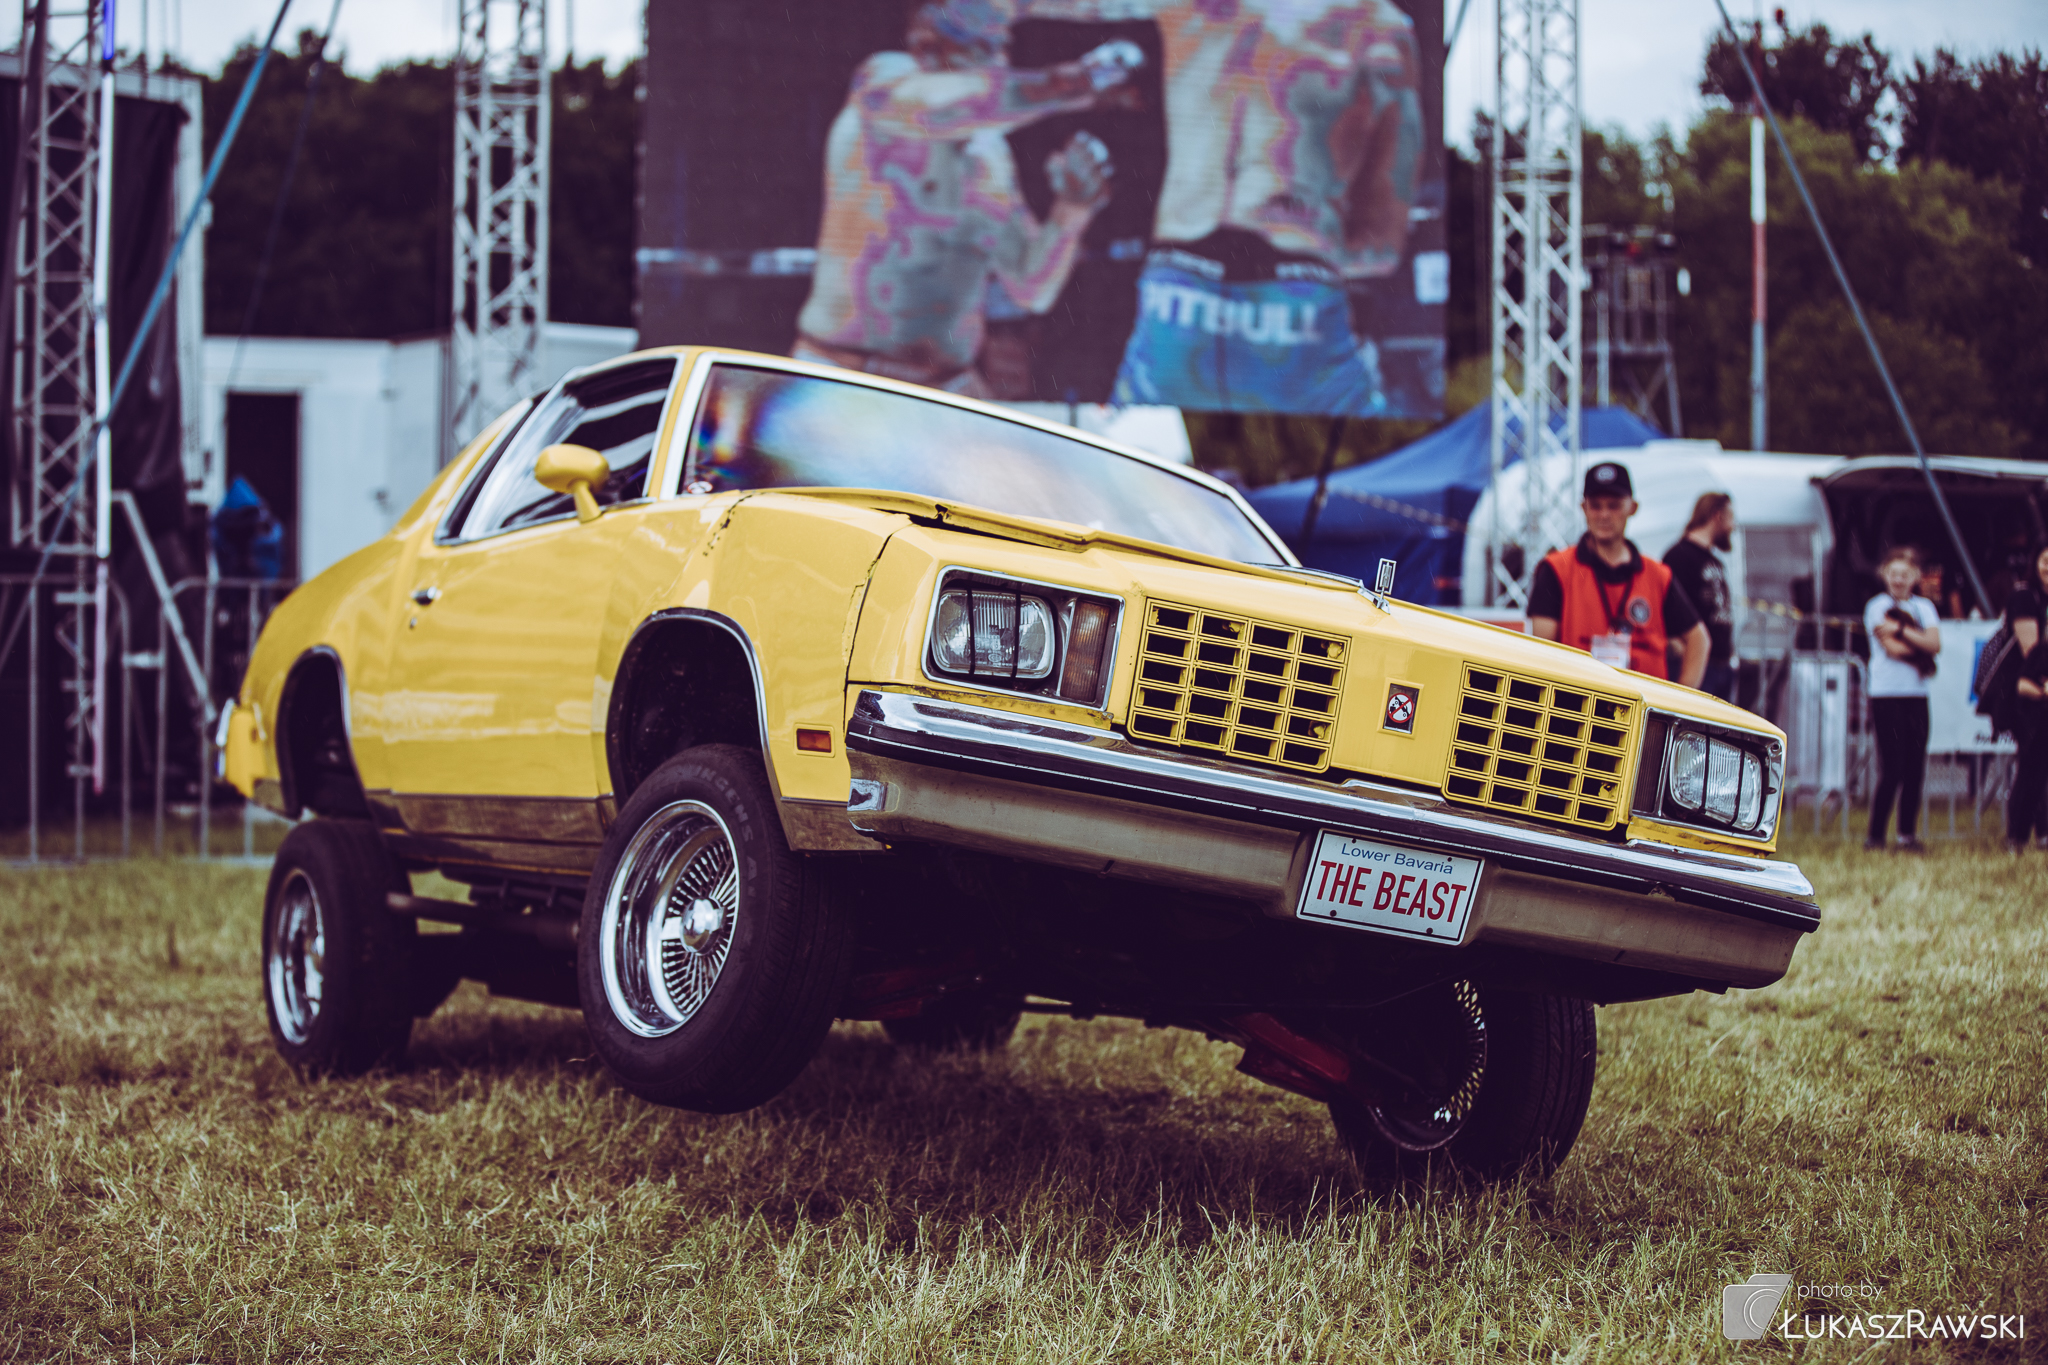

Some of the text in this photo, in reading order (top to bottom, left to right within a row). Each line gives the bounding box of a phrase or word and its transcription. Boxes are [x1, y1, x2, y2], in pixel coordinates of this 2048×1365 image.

[1341, 843, 1453, 875] Lower Bavaria
[1316, 860, 1467, 923] THE BEAST
